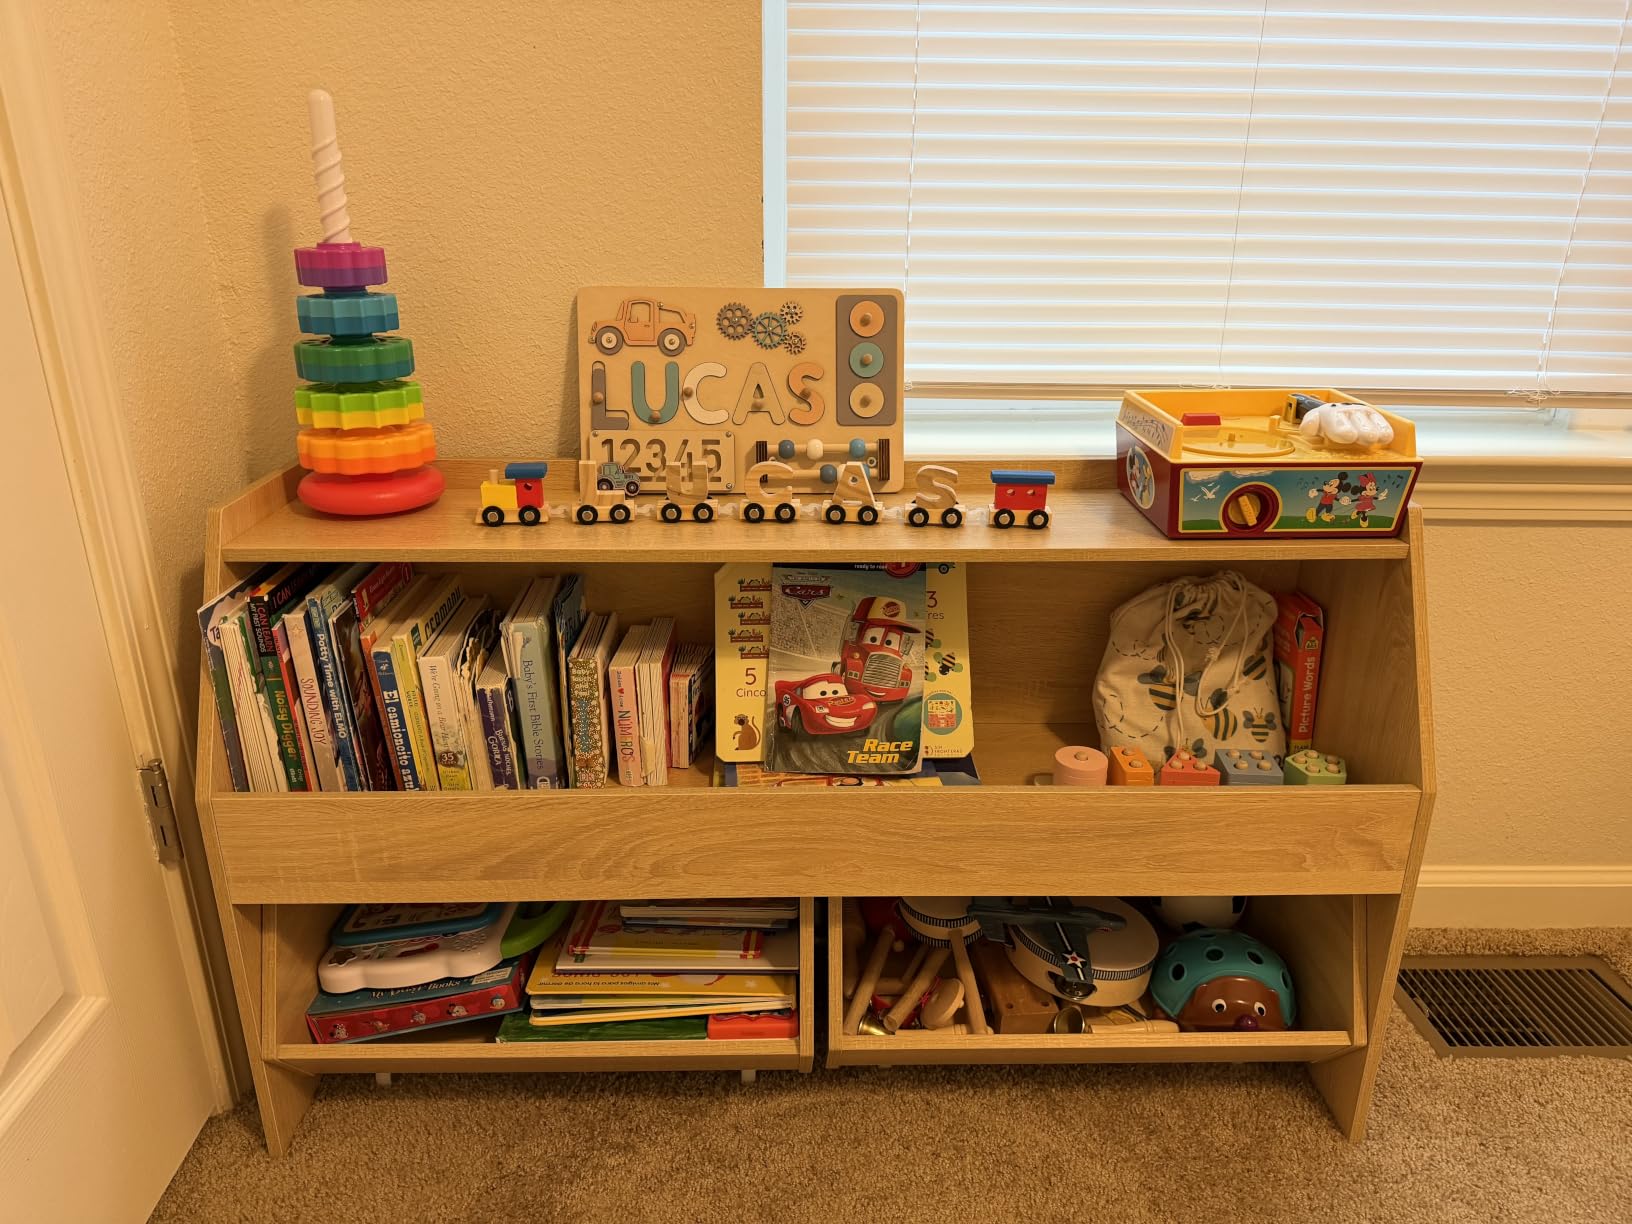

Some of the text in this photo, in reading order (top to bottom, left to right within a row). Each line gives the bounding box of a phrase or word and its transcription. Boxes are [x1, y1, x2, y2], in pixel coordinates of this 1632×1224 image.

[591, 361, 826, 430] LUCAS
[601, 439, 722, 483] 12345
[785, 585, 825, 596] Cars
[926, 590, 938, 608] 3
[926, 610, 945, 621] res
[256, 628, 267, 653] SOUNDS
[258, 607, 268, 626] CAN
[263, 628, 275, 653] LEARN
[316, 633, 347, 739] Potty Time with ELMO
[745, 667, 757, 685] 5
[1302, 656, 1316, 691] Words
[383, 690, 399, 704] El
[736, 687, 767, 698] Cinco
[301, 678, 327, 745] SOUNDING JOY
[521, 659, 545, 770] Baby's First Bible Stories
[1298, 693, 1312, 733] Picture
[274, 690, 297, 760] Noisy Digger
[387, 706, 411, 767] camioncito
[441, 753, 454, 762] 35
[847, 750, 899, 764] Team
[863, 738, 913, 752] Race
[427, 980, 461, 990] Books
